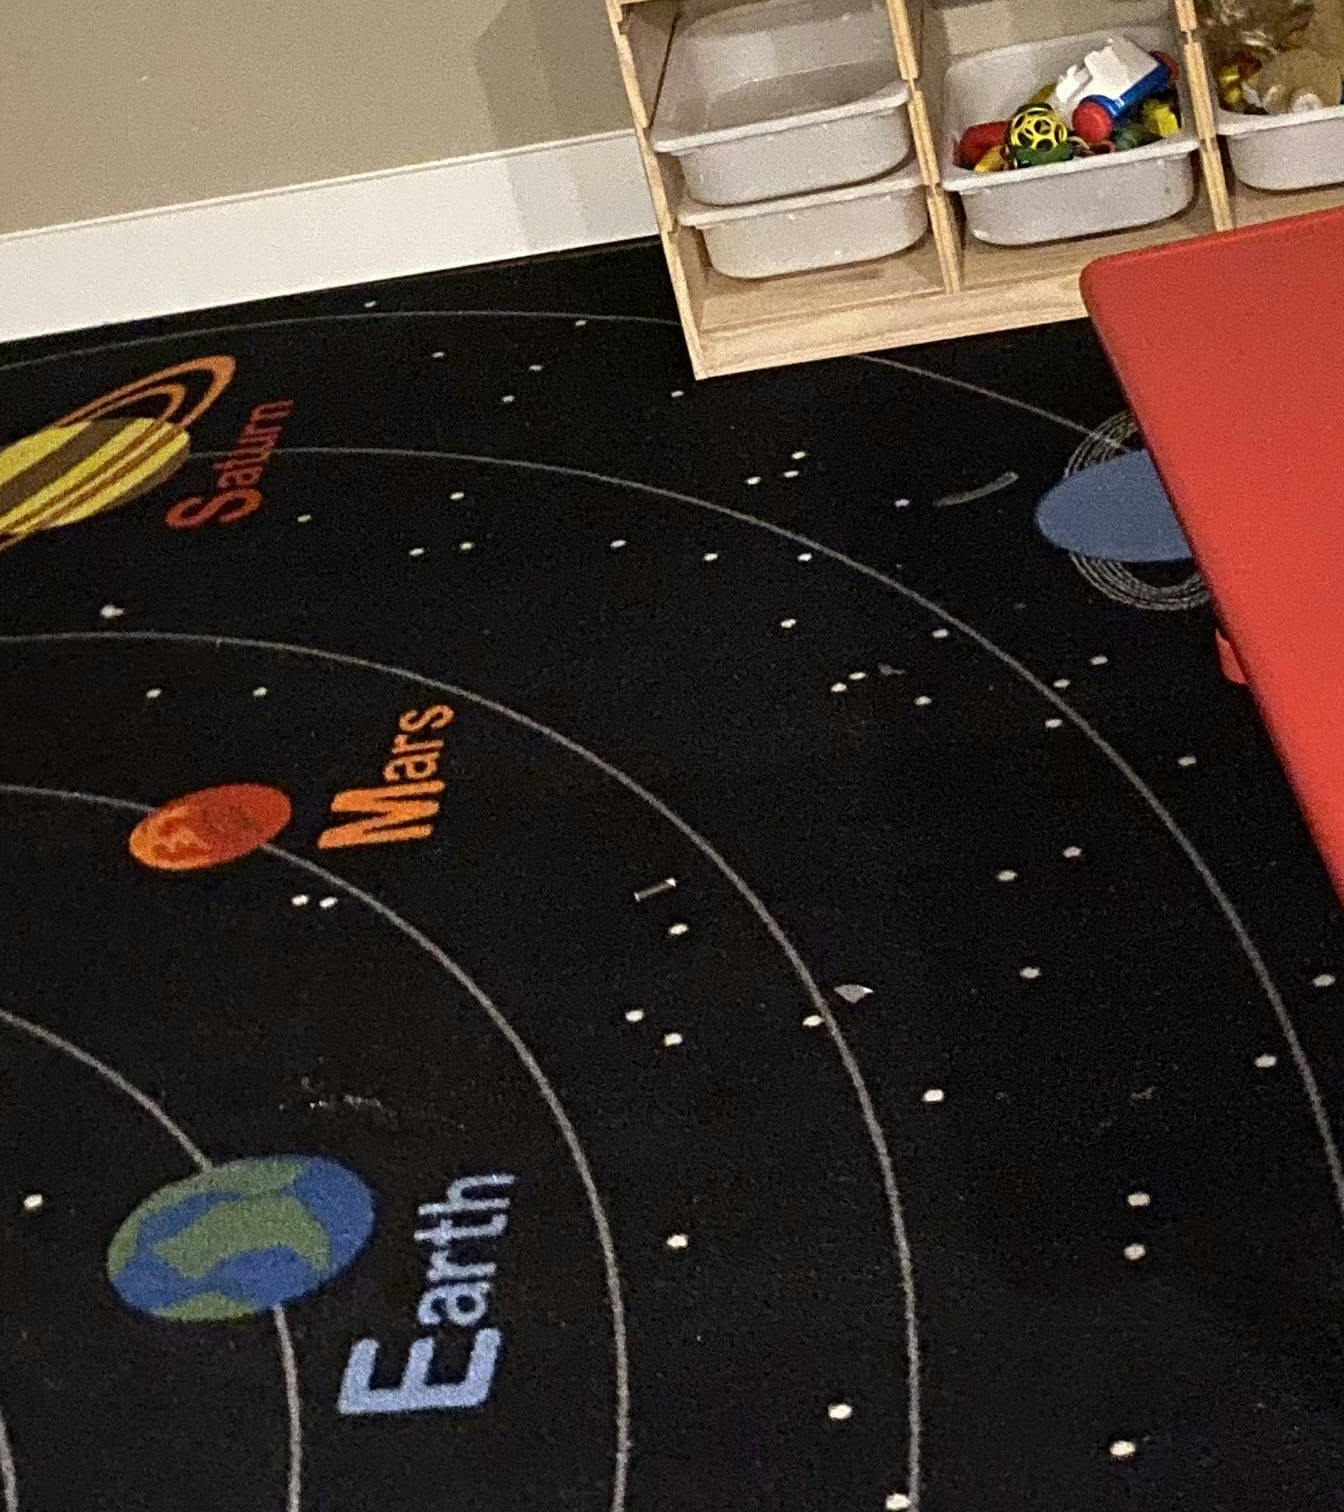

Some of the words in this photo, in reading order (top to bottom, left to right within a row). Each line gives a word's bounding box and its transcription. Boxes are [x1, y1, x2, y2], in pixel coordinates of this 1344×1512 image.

[165, 399, 294, 529] Saturn
[318, 703, 456, 851] Mars
[338, 1172, 518, 1416] Earth
